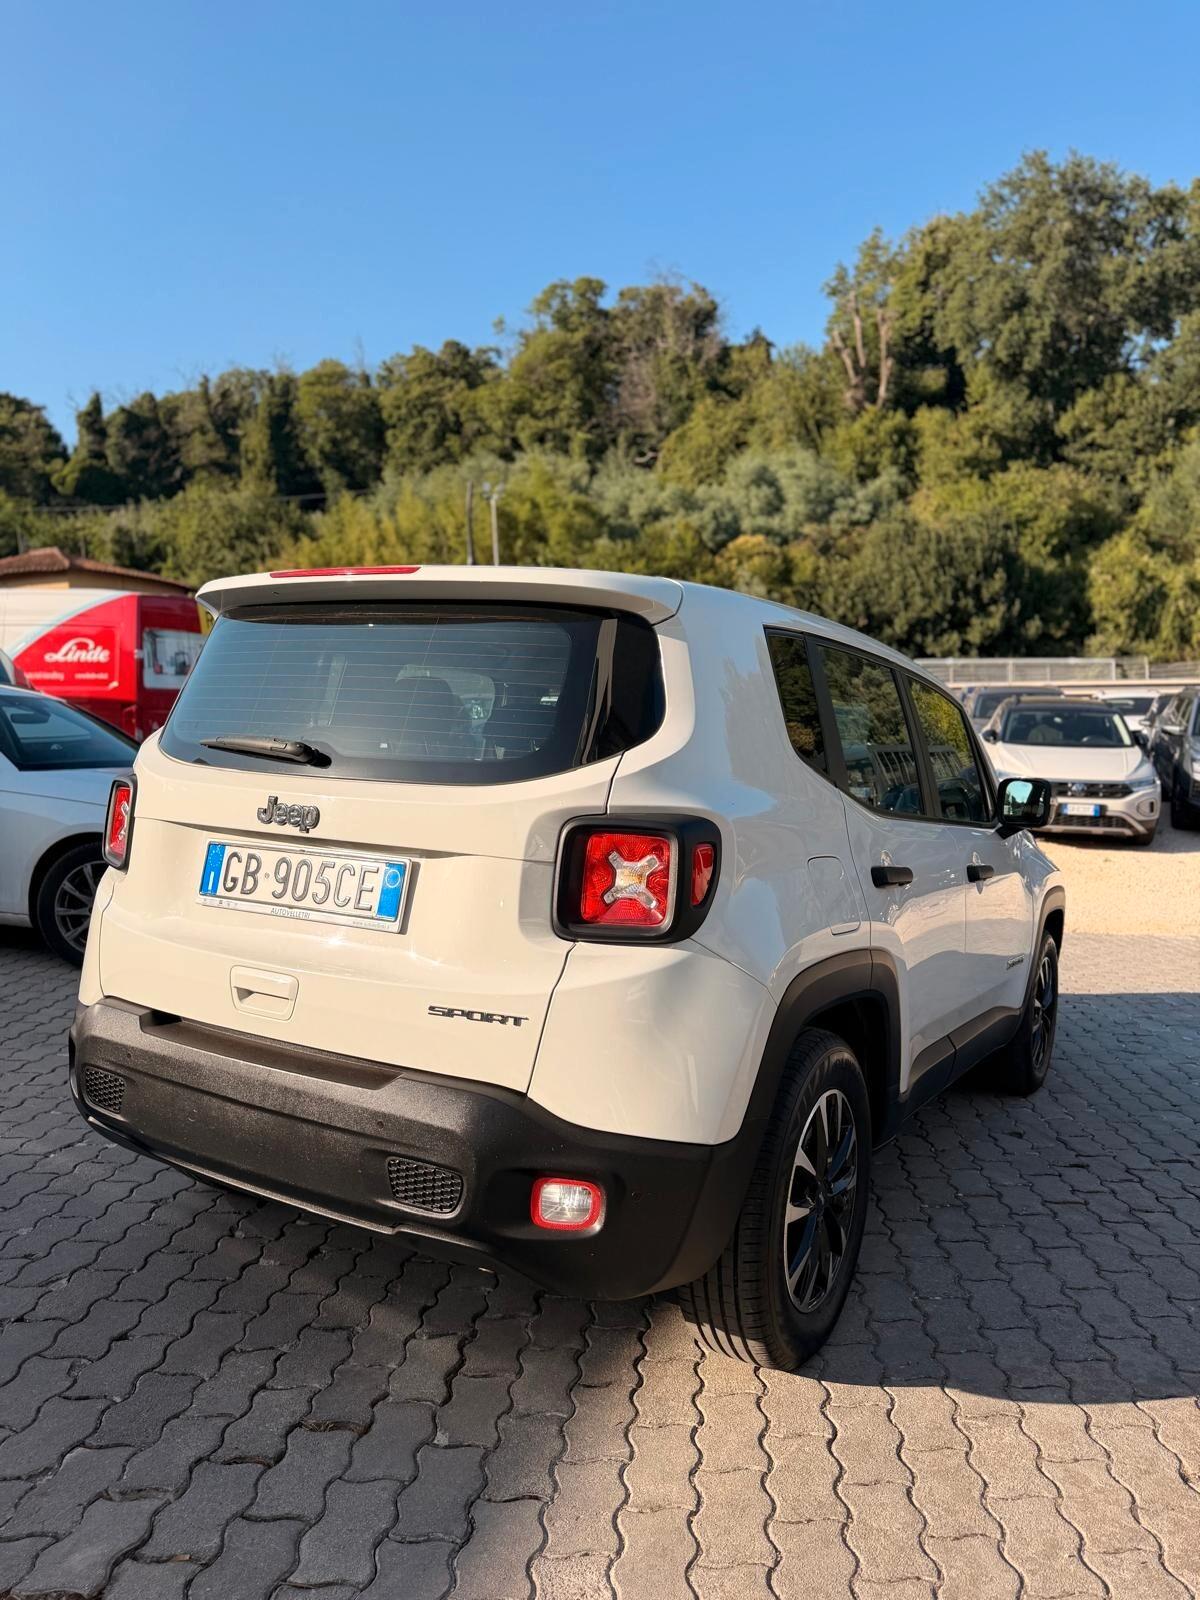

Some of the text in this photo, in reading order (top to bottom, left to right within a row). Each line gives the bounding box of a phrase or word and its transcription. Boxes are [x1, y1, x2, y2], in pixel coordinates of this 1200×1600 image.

[44, 637, 110, 663] Linde
[257, 795, 321, 834] Jeep
[427, 1005, 530, 1027] SPORT
